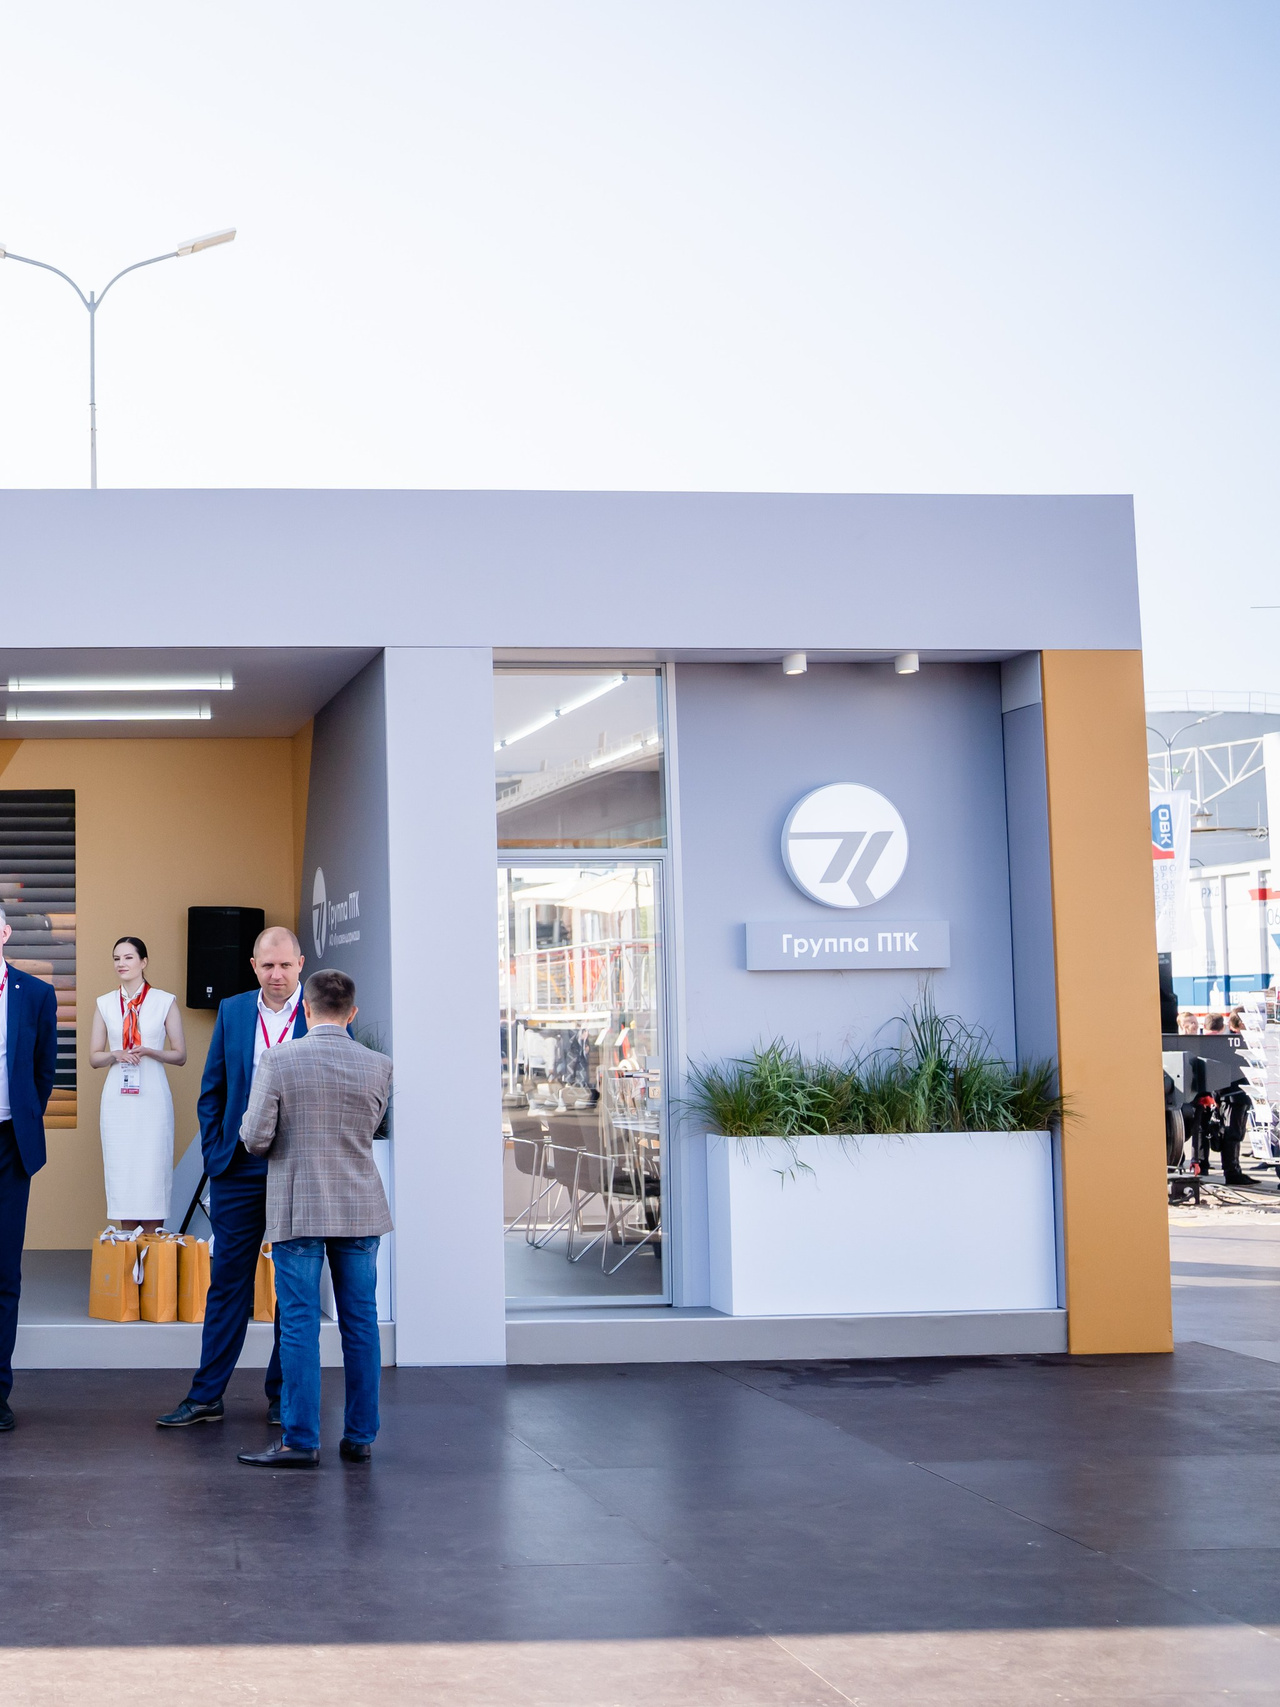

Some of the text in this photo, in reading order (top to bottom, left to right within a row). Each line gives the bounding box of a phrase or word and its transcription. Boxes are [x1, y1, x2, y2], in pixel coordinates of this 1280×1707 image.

[1158, 808, 1172, 845] ОВК
[328, 890, 360, 931] Группа ПТК
[782, 931, 919, 958] Группа ПТК
